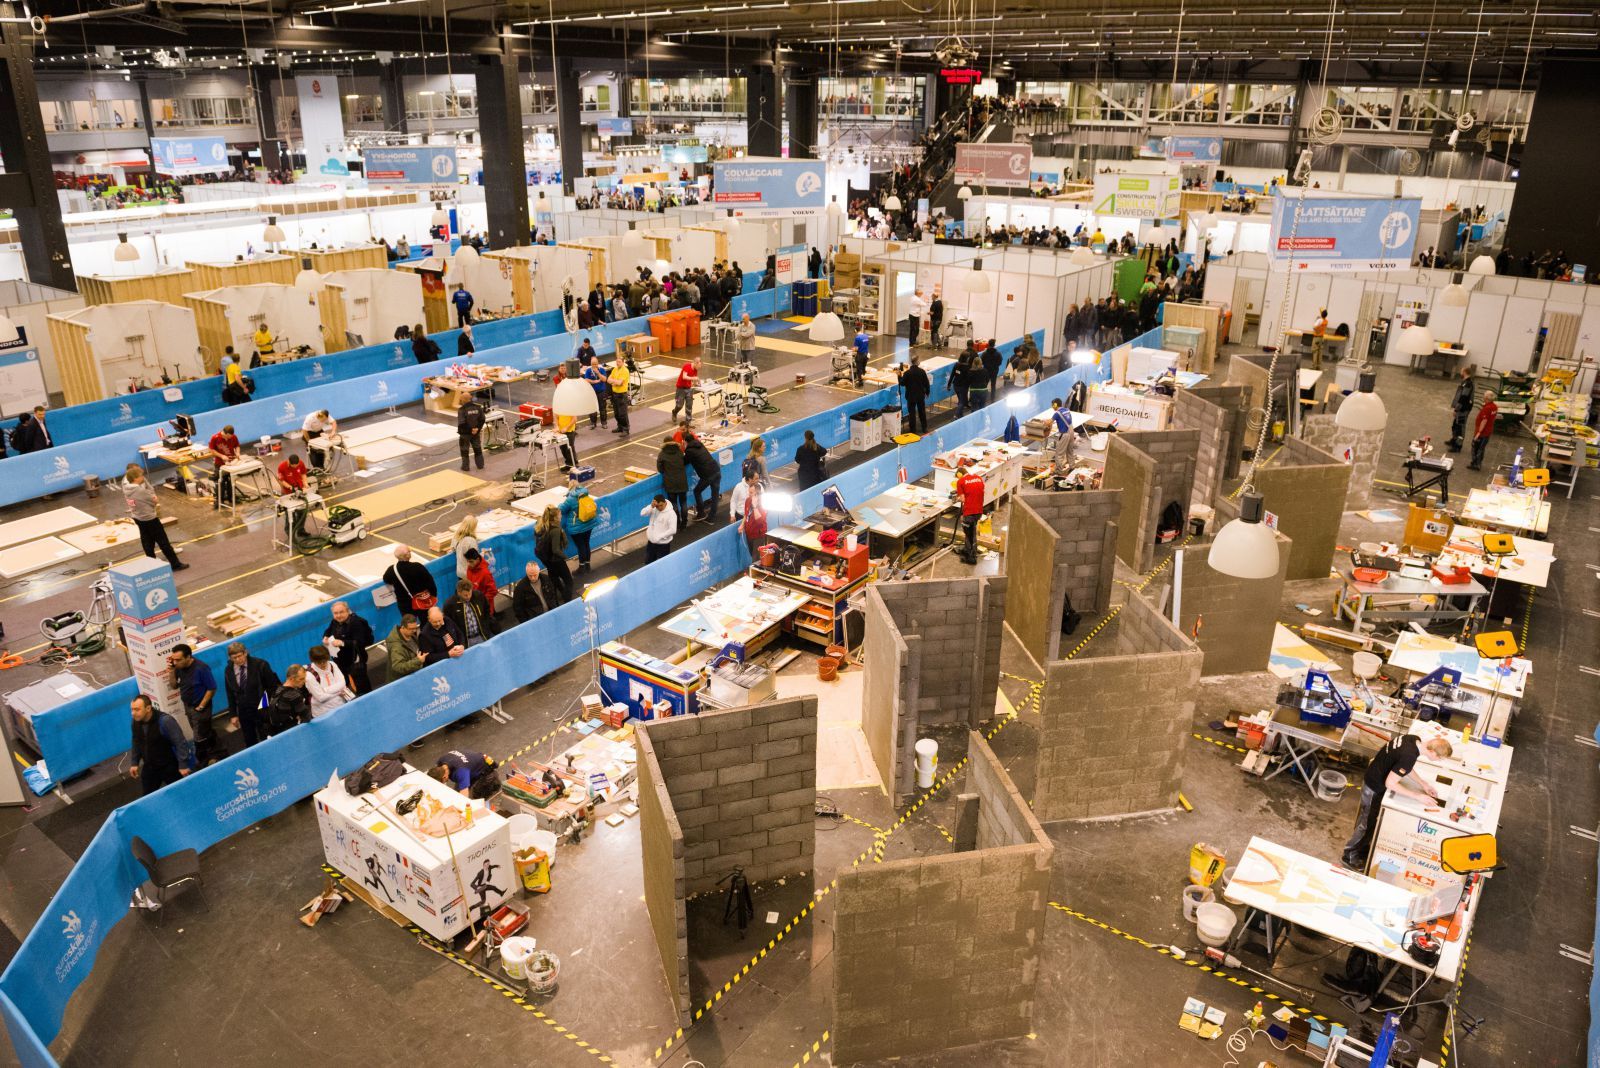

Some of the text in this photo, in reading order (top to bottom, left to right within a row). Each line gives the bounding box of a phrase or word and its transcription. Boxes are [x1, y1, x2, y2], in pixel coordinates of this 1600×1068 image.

[1116, 199, 1156, 209] SKILLS
[1116, 208, 1155, 217] SWEDEN
[1099, 404, 1149, 420] BERGDAHLS
[154, 635, 181, 650] FESTO
[415, 694, 450, 715] euroskills
[416, 692, 471, 722] Gothenburg 2016
[215, 787, 260, 816] euroskills
[216, 782, 288, 822] Gothenburg 2016
[466, 839, 497, 864] THOMAS
[1417, 860, 1440, 872] MAPEI
[1405, 870, 1436, 887] PCI
[55, 931, 85, 976] euroskills
[57, 933, 92, 984] Gothenburg
